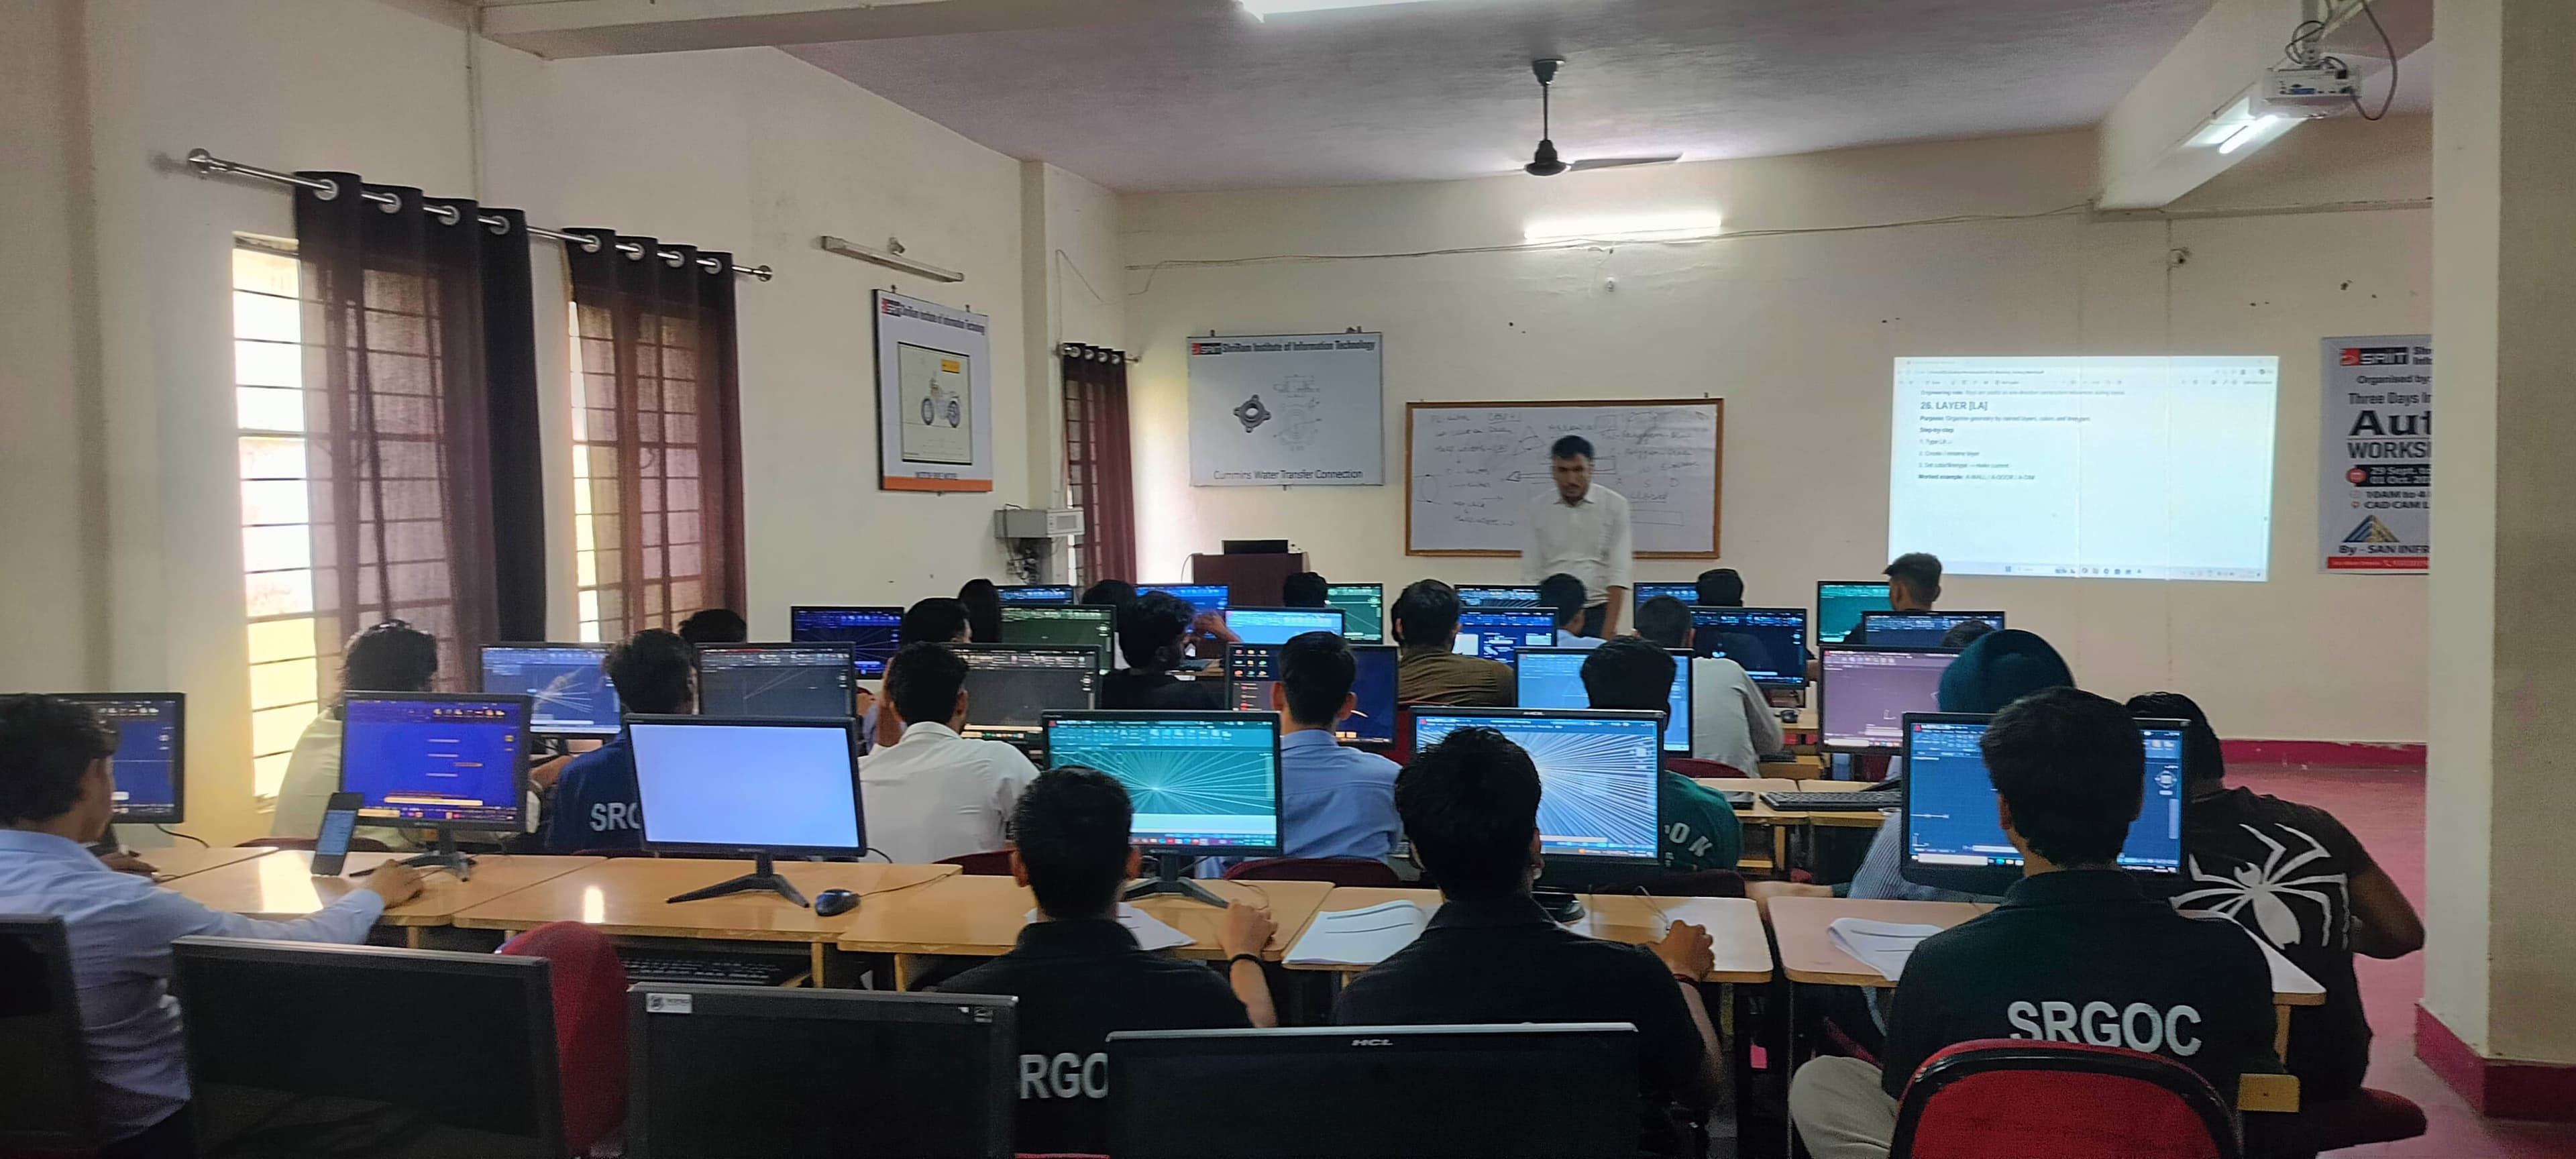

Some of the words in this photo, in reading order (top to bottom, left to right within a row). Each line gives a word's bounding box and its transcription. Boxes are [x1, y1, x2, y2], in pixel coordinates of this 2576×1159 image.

[2356, 376, 2413, 385] Organised
[2348, 393, 2385, 404] Three
[2387, 392, 2419, 406] Days
[1936, 402, 1967, 410] LAYER
[1254, 470, 1279, 480] Water
[1280, 470, 1313, 480] Transfer
[1315, 470, 1364, 479] Connection
[2363, 501, 2390, 509] CAD
[2392, 501, 2421, 509] CAM
[2339, 545, 2357, 555] By
[2367, 545, 2396, 553] SAN
[2006, 1001, 2202, 1056] SRGOC
